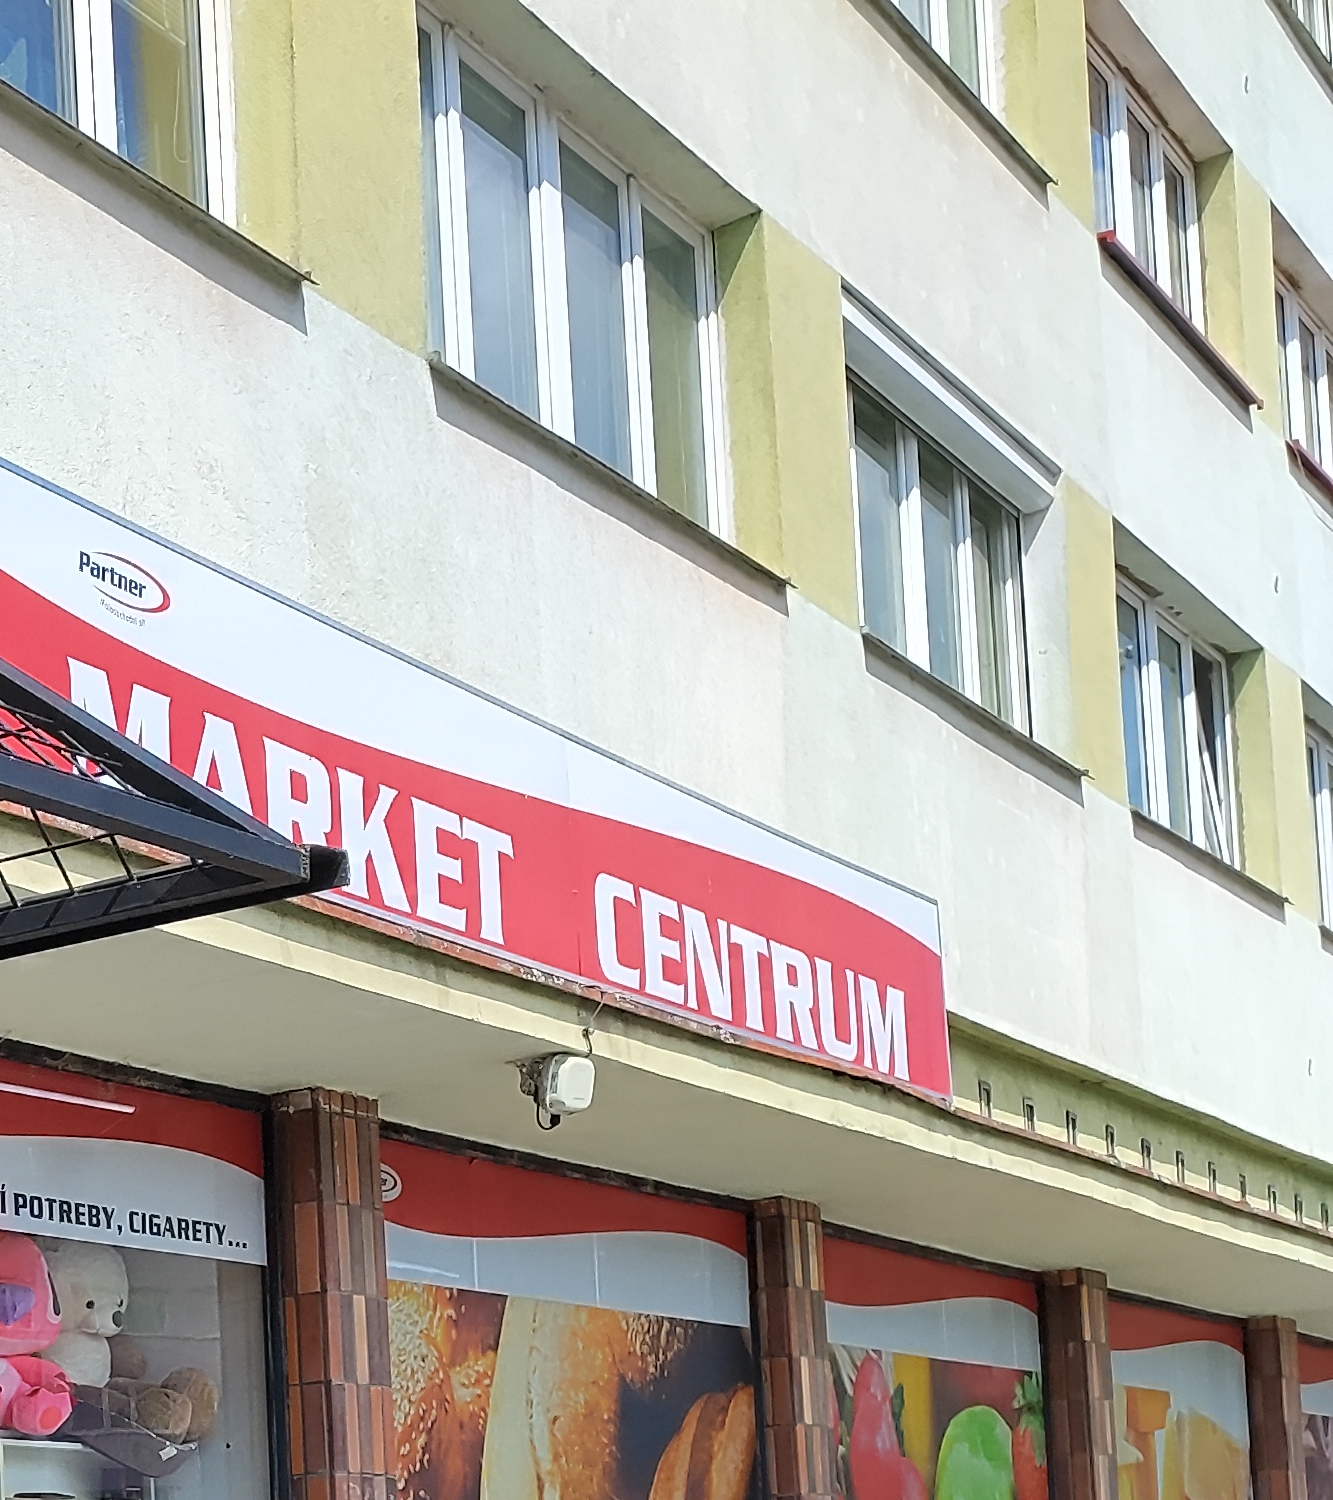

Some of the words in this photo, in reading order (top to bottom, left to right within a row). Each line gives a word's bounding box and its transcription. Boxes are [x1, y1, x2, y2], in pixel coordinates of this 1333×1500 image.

[79, 551, 146, 598] Partner
[67, 656, 515, 946] MARKET
[594, 873, 910, 1081] CENTRUM
[14, 1192, 124, 1236] POTREBY,
[129, 1210, 248, 1249] CIGARETY...
